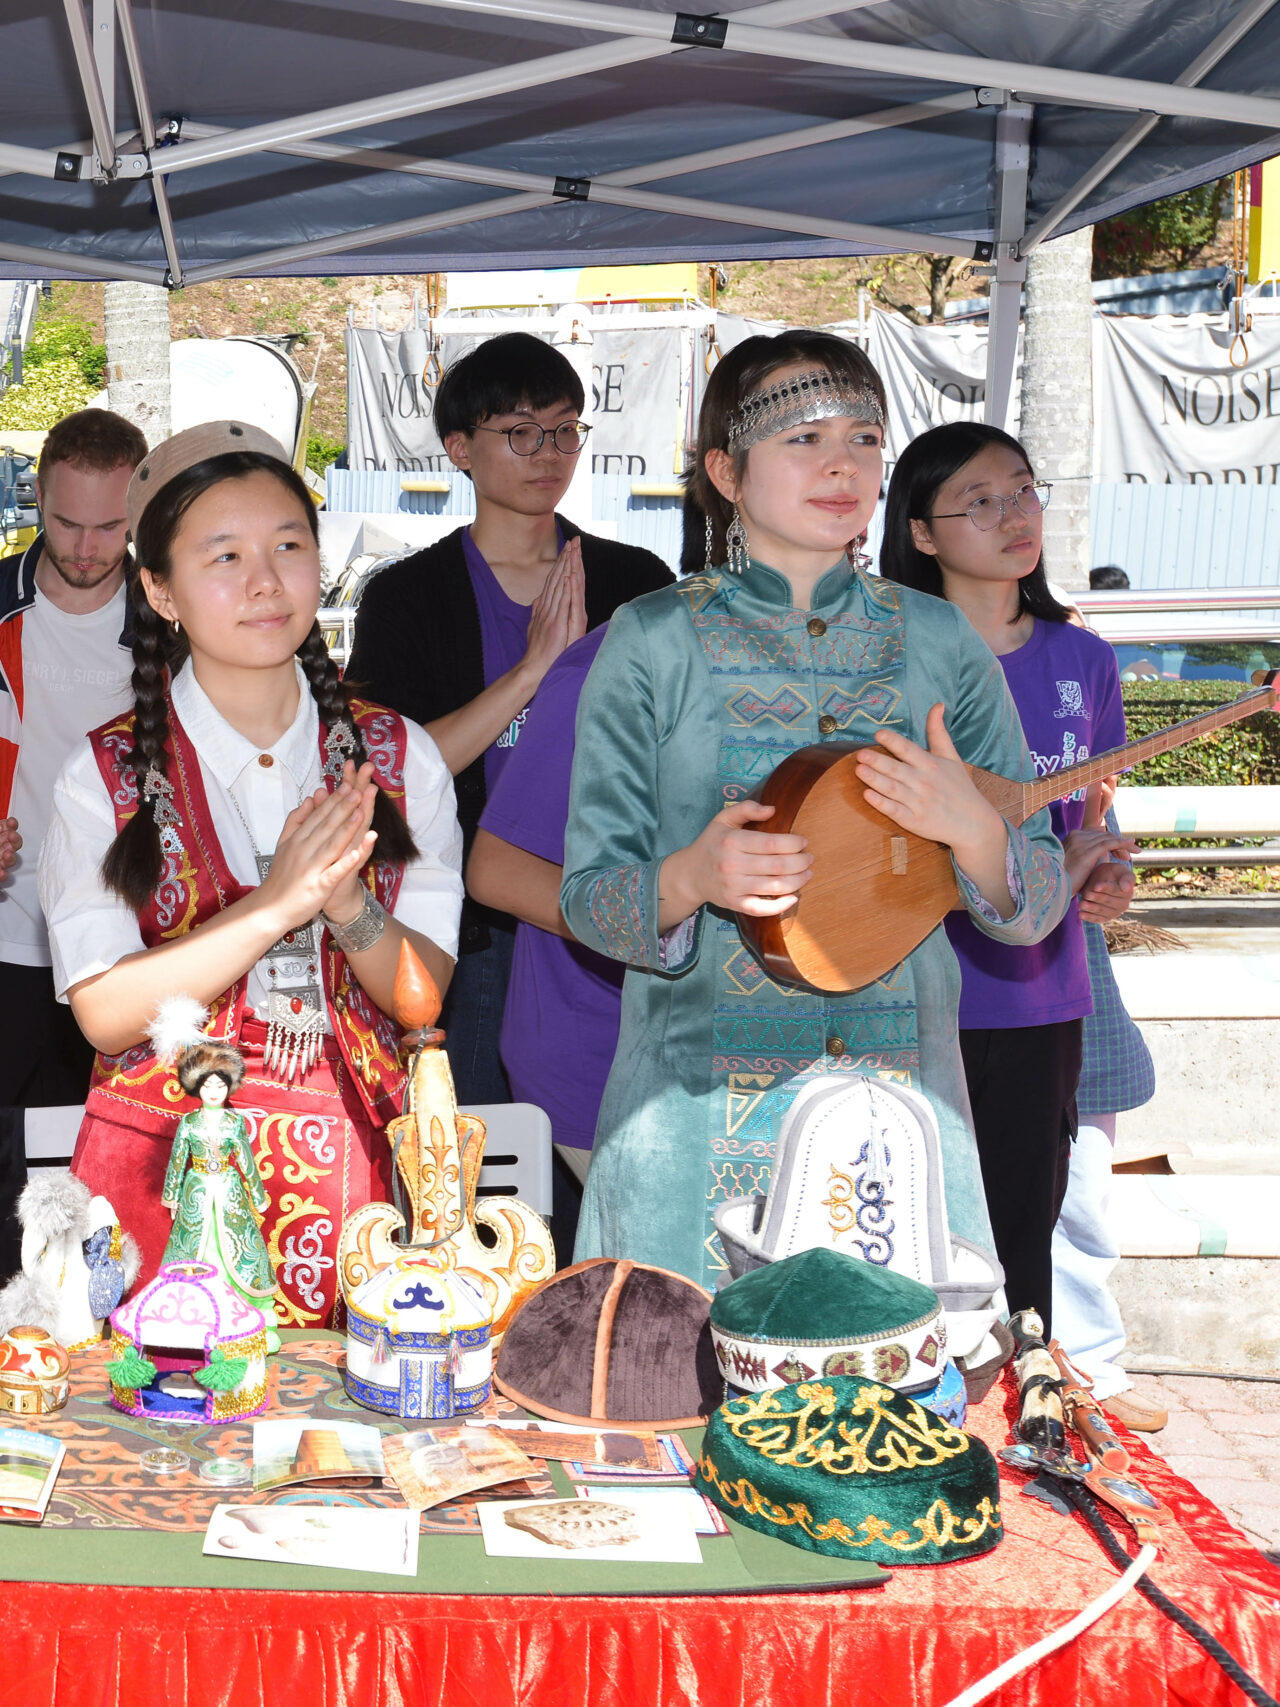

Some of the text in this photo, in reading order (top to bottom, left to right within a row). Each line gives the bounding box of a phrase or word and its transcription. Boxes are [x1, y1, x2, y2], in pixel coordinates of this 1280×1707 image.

[381, 372, 440, 418] NOIS
[1159, 366, 1280, 426] NOISE
[23, 662, 58, 681] ENRY
